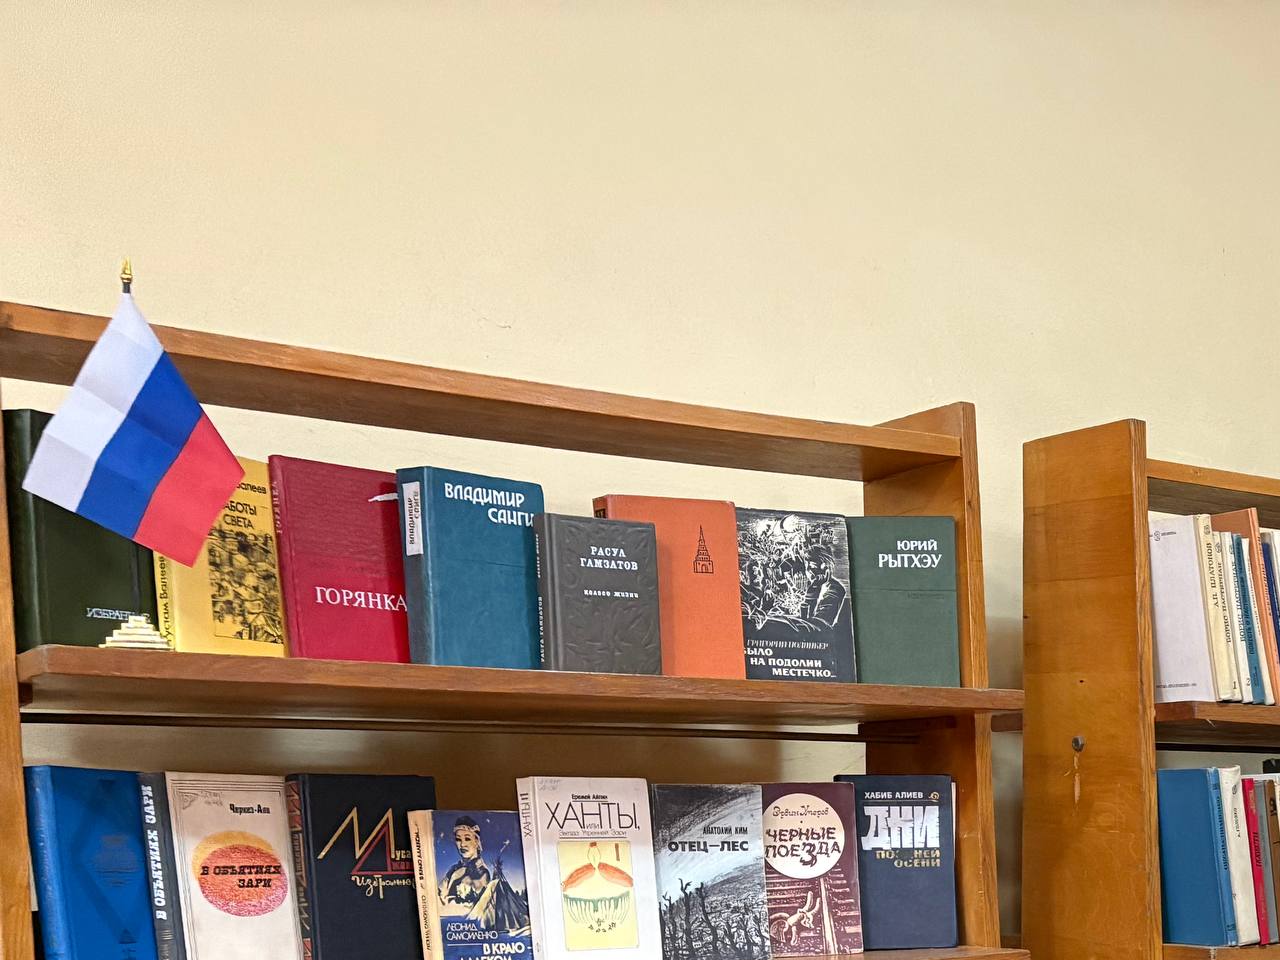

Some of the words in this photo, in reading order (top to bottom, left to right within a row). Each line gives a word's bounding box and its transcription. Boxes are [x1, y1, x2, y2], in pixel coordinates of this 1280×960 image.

[444, 482, 525, 508] ВЛАДИМИР
[224, 513, 254, 529] СВЕТА
[487, 507, 535, 528] САНГИ
[590, 546, 626, 558] РАСУЛ
[896, 540, 938, 551] ЮРИЙ
[580, 557, 639, 571] ГАМЗАТОВ
[878, 553, 942, 568] РЫТХЭУ
[315, 587, 407, 611] ГОРЯНКА
[750, 657, 766, 666] НА
[770, 658, 822, 668] ПОДОЛИИ
[864, 791, 893, 800] ХАБИБ
[894, 791, 924, 800] АЛИЕВ
[734, 826, 748, 836] КИМ
[766, 827, 837, 843] ЧЕРНЫЕ
[860, 805, 941, 851] ДНИ
[764, 841, 841, 866] ПОЕЗДА
[200, 865, 209, 876] В
[212, 864, 283, 876] ОБЪЯТИЯХ
[236, 877, 273, 889] ЗАРИ
[483, 943, 491, 955] В
[493, 942, 526, 954] КРАЮ
